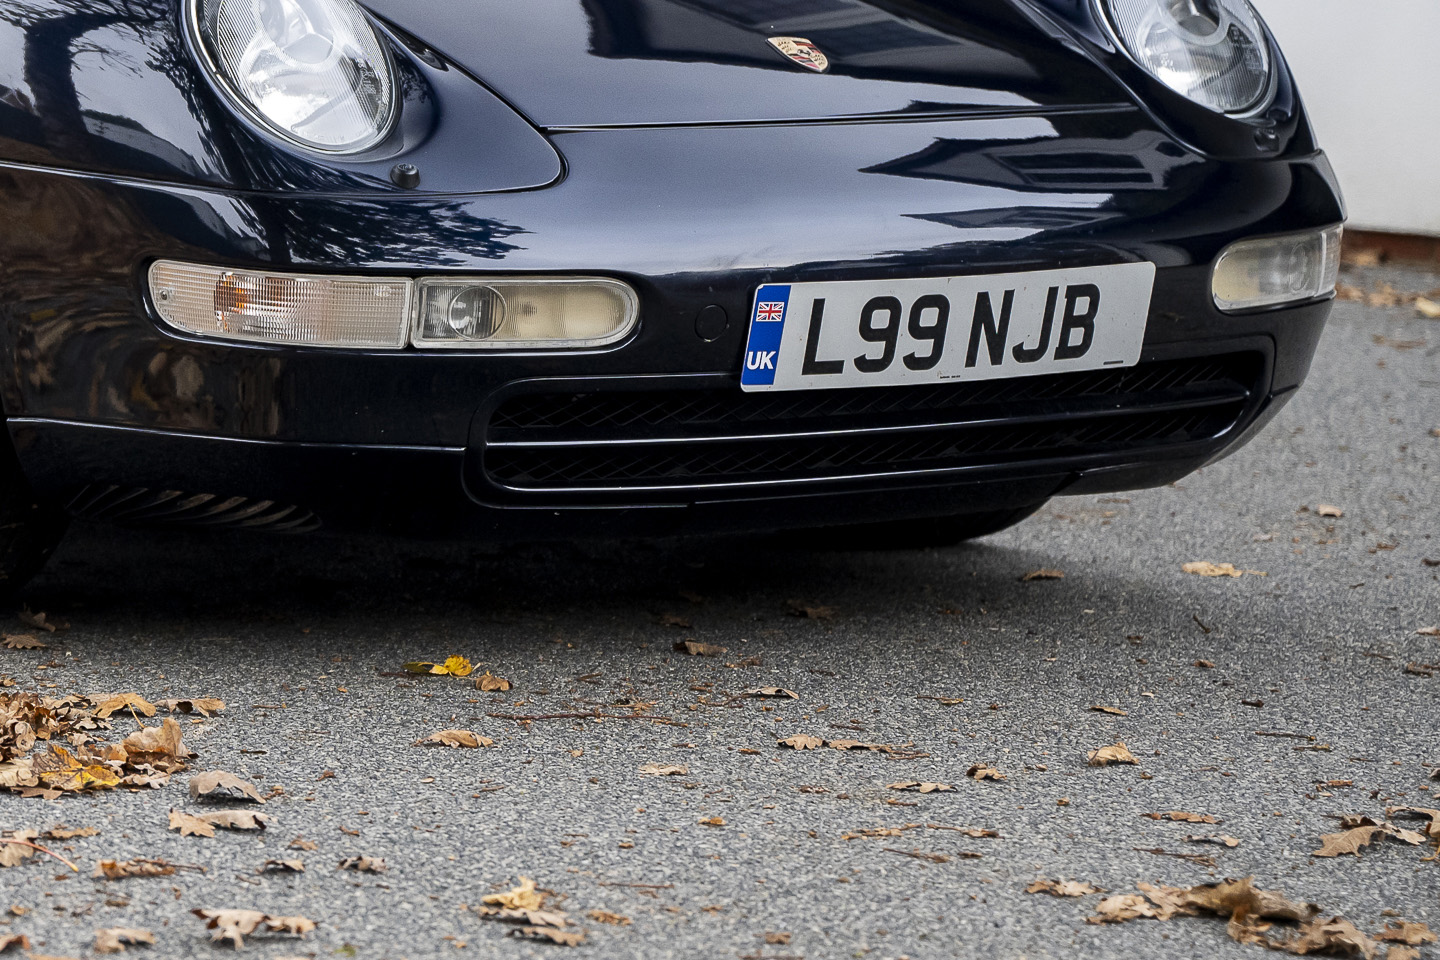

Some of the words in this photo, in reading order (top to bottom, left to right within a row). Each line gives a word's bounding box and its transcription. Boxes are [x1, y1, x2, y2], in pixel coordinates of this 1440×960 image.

[801, 294, 951, 376] L99
[964, 283, 1102, 369] NJB
[746, 351, 777, 370] UK
